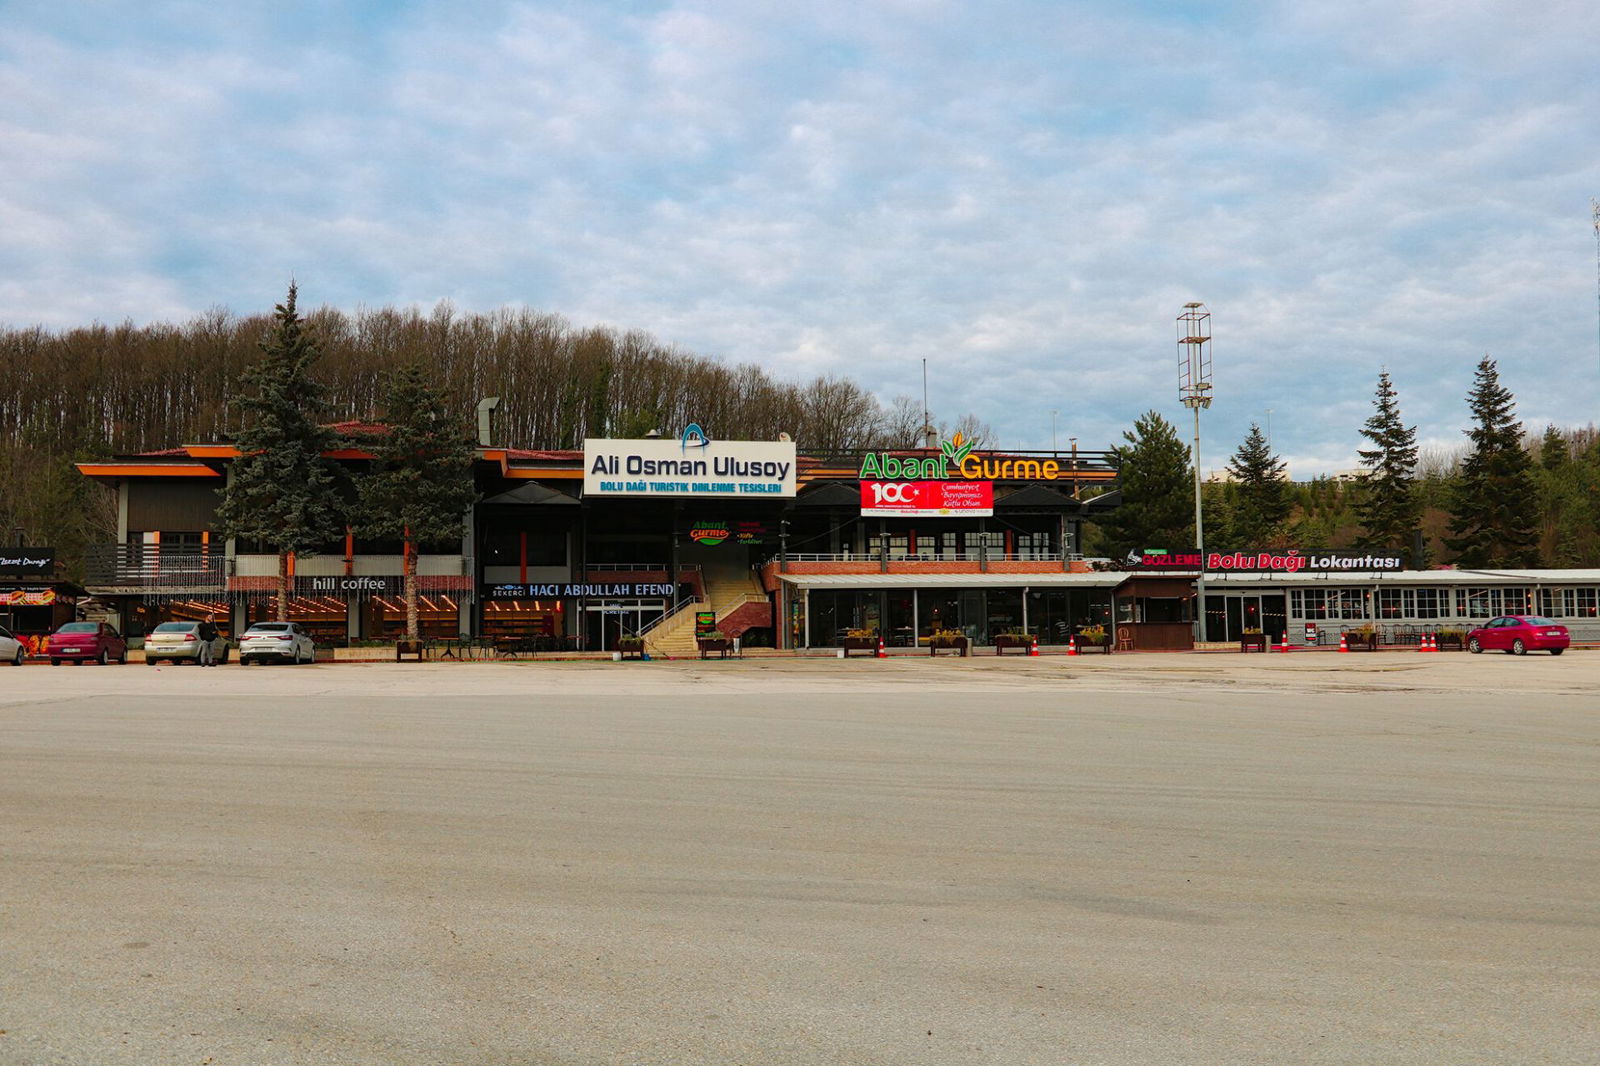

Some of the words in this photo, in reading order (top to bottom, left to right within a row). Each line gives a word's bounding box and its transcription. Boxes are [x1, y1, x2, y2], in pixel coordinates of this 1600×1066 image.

[591, 454, 619, 475] Ali
[626, 455, 707, 476] Osman
[713, 456, 790, 481] Ulusoy
[859, 452, 950, 480] Abant
[959, 454, 1060, 480] Gurme
[600, 481, 624, 492] BOLU
[625, 479, 647, 492] DAĞI
[1207, 552, 1255, 569] Bolu
[1257, 550, 1306, 573] Dağı
[1310, 555, 1400, 569] Lokantası
[313, 577, 335, 590] hill
[341, 577, 386, 590] coffee
[529, 584, 559, 596] HACI
[563, 584, 630, 596] ABDULLAH
